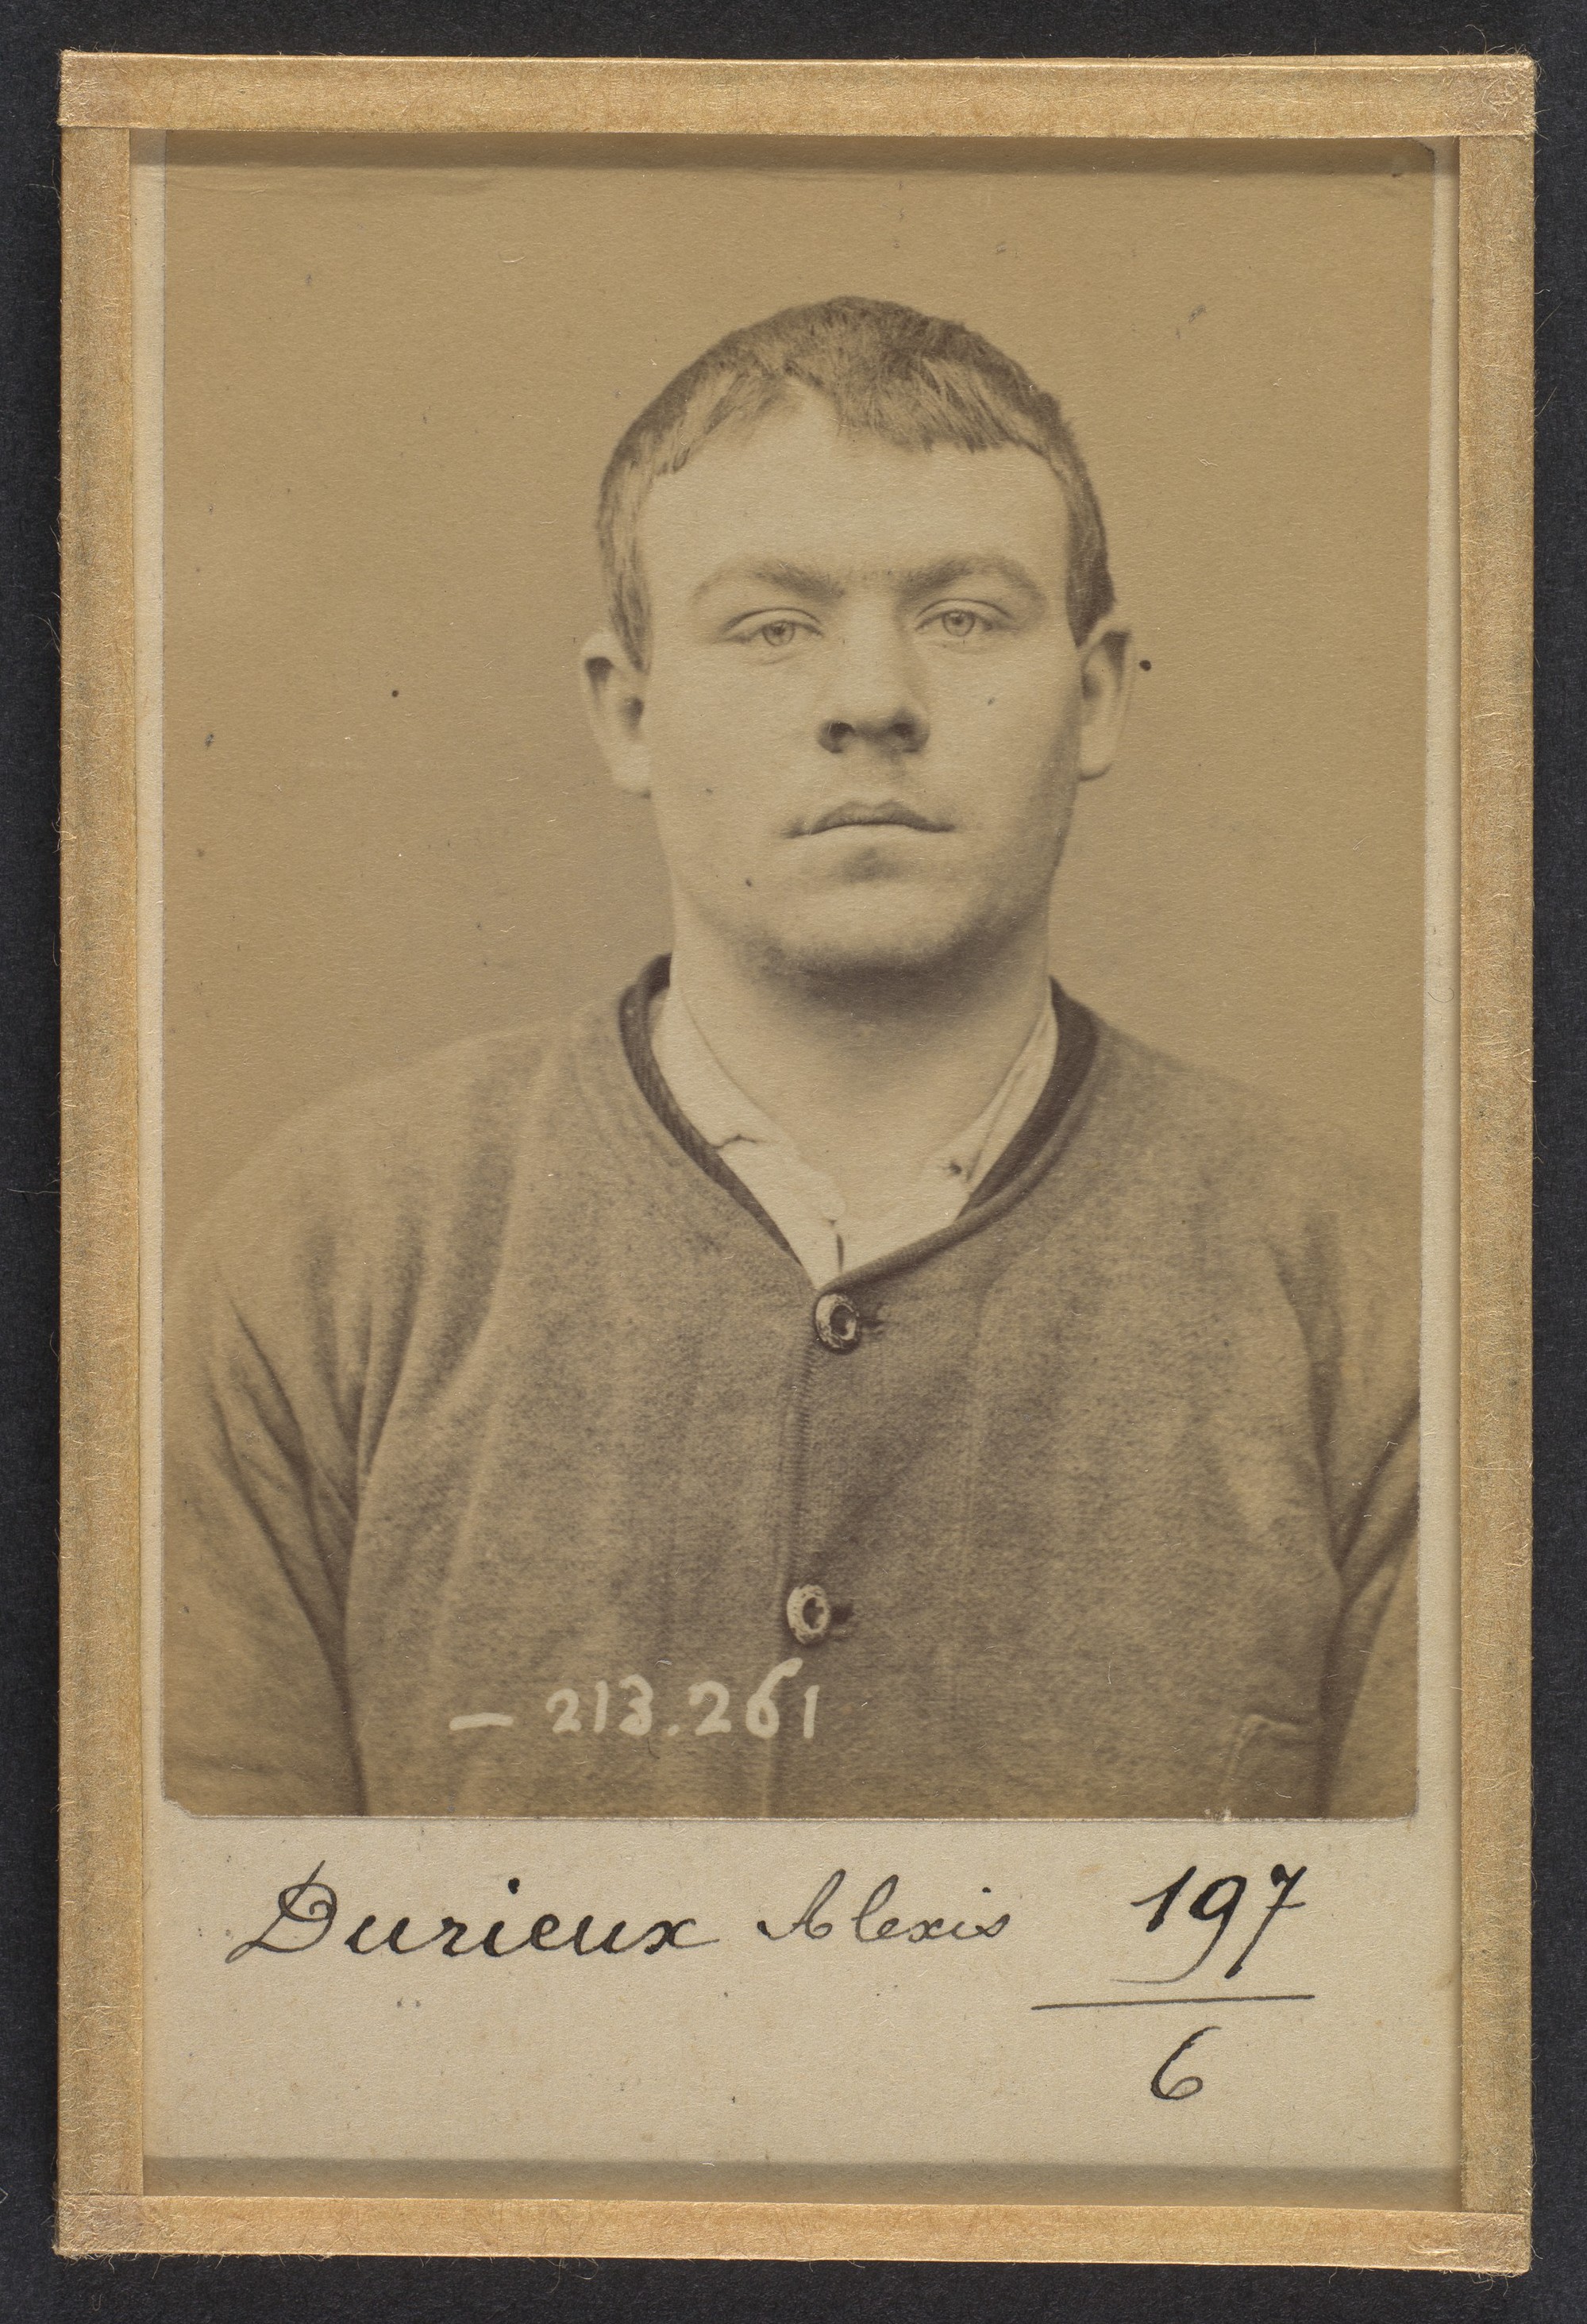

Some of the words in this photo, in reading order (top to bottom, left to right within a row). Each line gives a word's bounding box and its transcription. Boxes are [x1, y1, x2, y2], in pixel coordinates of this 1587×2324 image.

[545, 1657, 820, 1738] 213.261
[225, 1860, 720, 1964] Durieux
[757, 1869, 1010, 1942] Alexis
[1111, 1863, 1308, 1984] 197
[1150, 2025, 1222, 2100] 6
